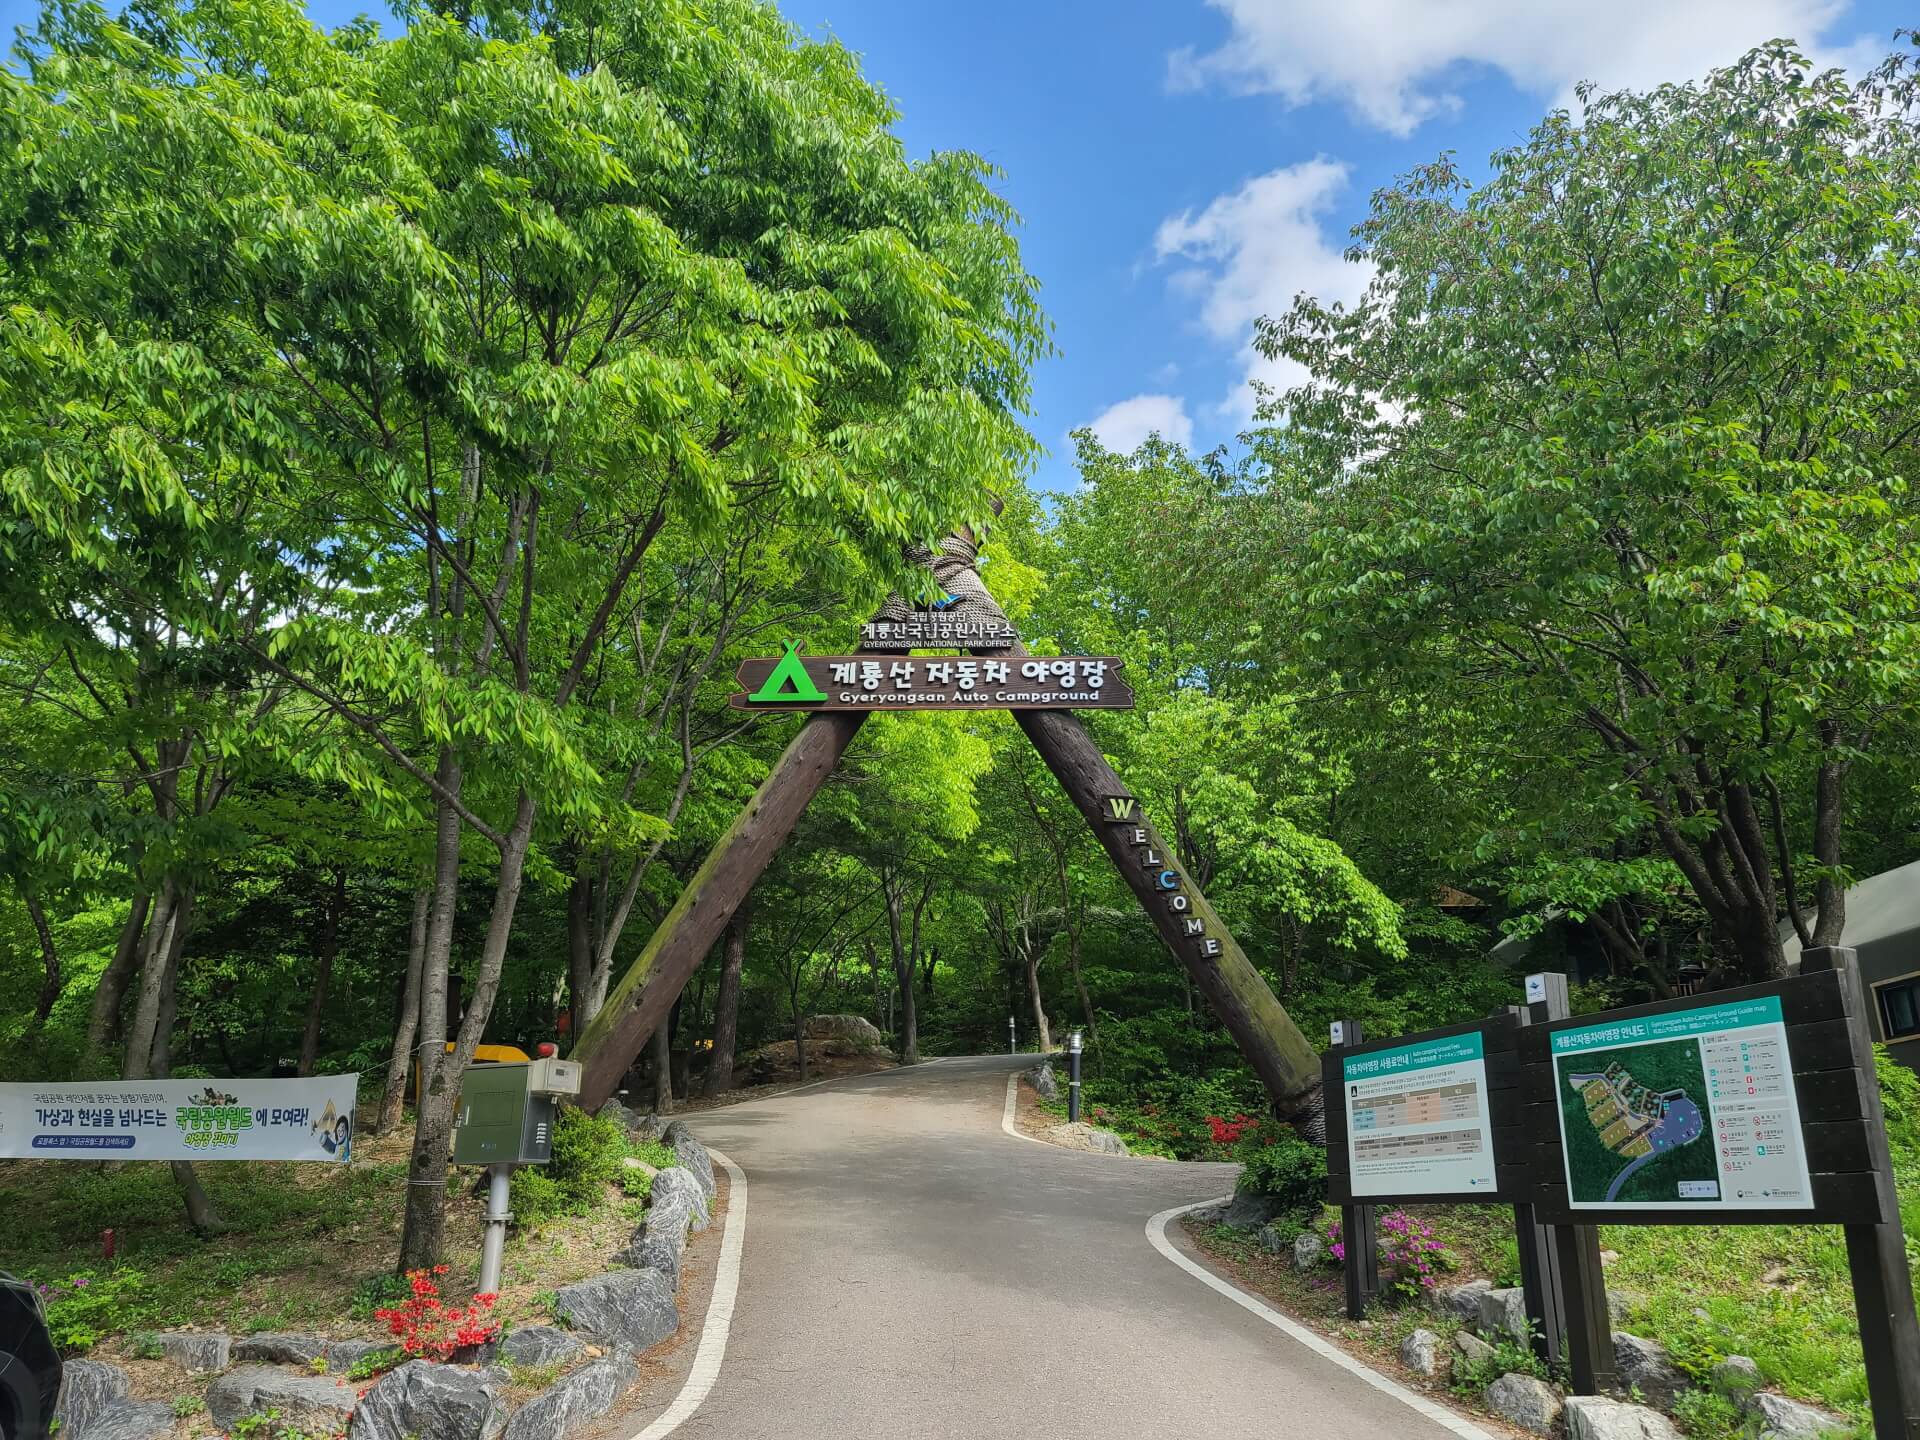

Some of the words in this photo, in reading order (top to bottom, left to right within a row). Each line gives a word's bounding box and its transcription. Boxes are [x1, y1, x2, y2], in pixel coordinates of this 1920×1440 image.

[860, 622, 1017, 639] 계룡산국립공원사무소
[864, 640, 922, 648] GYERYONGSAN
[924, 639, 963, 647] NATIONAL
[964, 639, 984, 647] PARK
[986, 639, 1012, 647] OFFICE
[829, 661, 916, 691] 계룡산
[925, 660, 1012, 690] 자동차
[1021, 660, 1108, 688] 야영장
[839, 692, 946, 704] Gyeryongsan
[952, 691, 989, 702] Auto
[995, 690, 1100, 703] Campground
[1109, 798, 1219, 954] WELCOME
[1621, 1024, 1647, 1039] 안내도
[1346, 1060, 1379, 1075] 자동차야영장
[35, 1108, 75, 1127] 가상과
[78, 1108, 115, 1127] 현실을
[119, 1108, 168, 1127] 넘나드는
[175, 1106, 253, 1131] 국립공원월드
[255, 1108, 267, 1127] 에
[270, 1107, 309, 1127] 모여라!
[184, 1131, 213, 1148] 야영장
